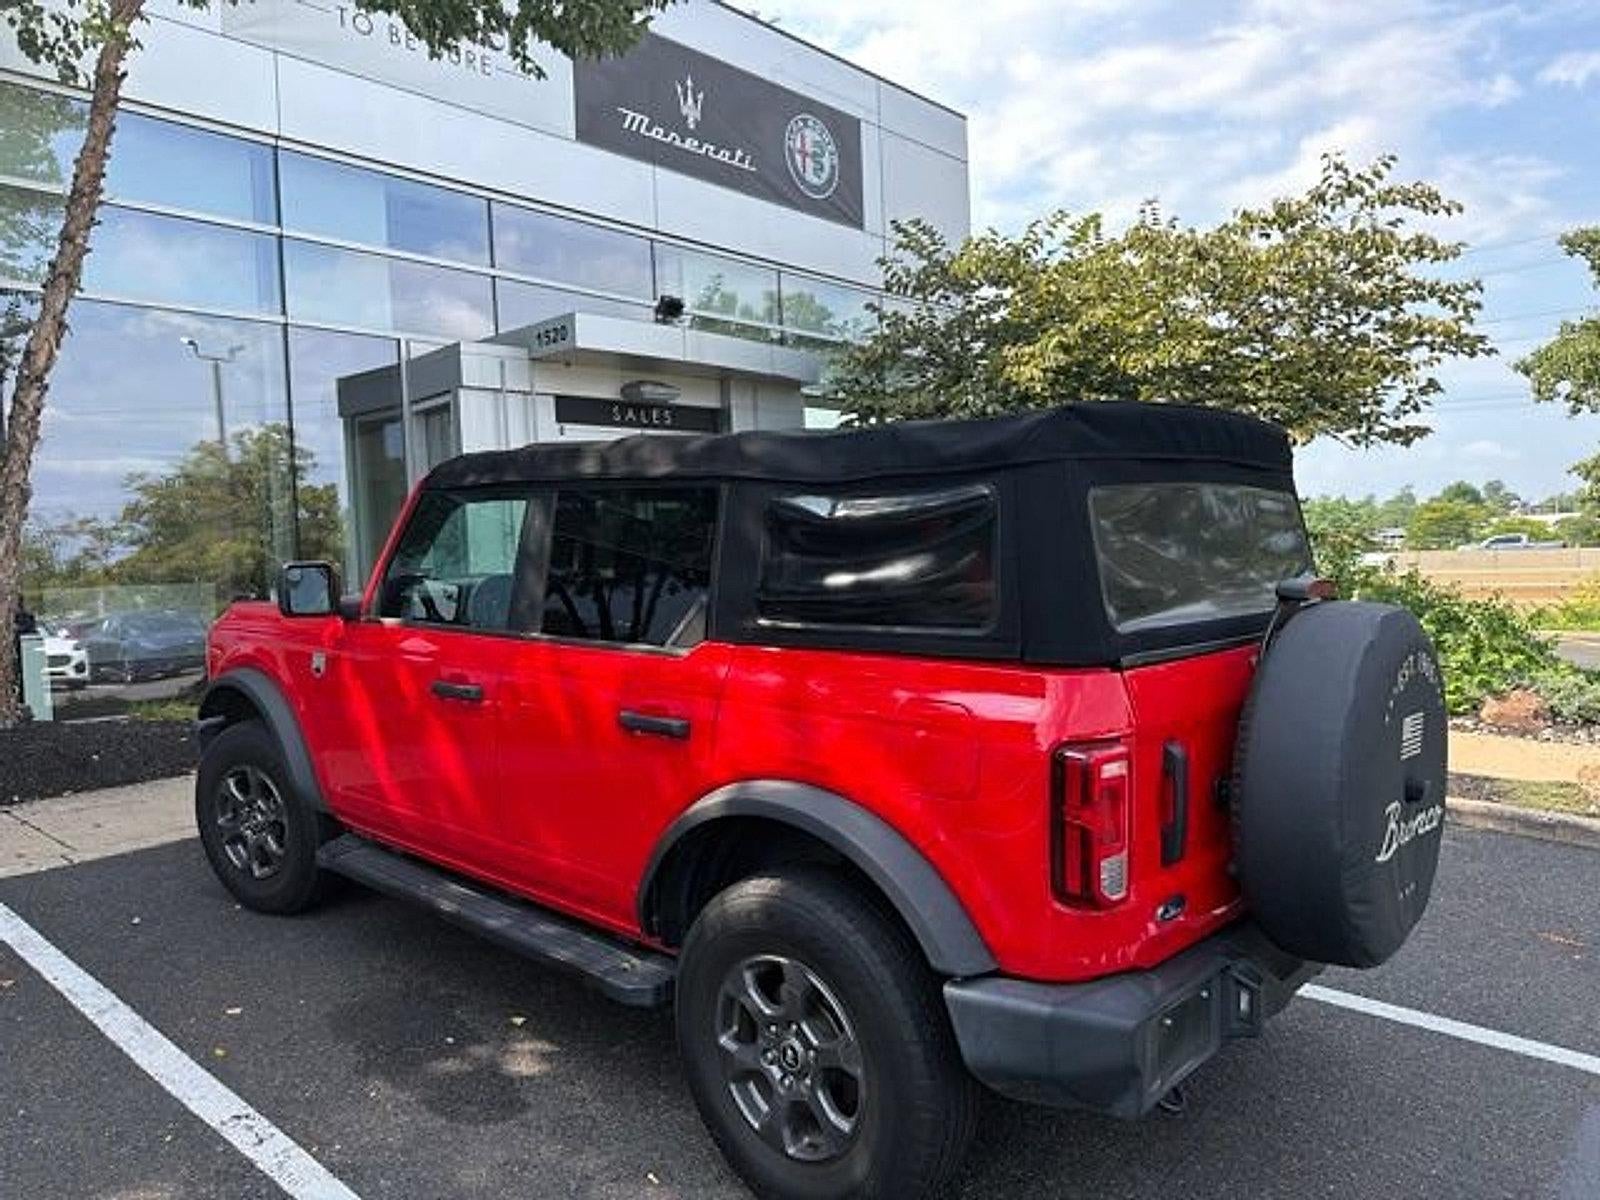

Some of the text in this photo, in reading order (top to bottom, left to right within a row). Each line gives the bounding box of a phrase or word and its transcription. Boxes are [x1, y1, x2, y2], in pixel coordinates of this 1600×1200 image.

[336, 7, 374, 36] TO
[388, 23, 417, 51] BE
[617, 106, 757, 171] Maserati
[535, 325, 569, 348] 1520
[611, 405, 672, 425] SALES
[1374, 800, 1442, 862] Bronco
